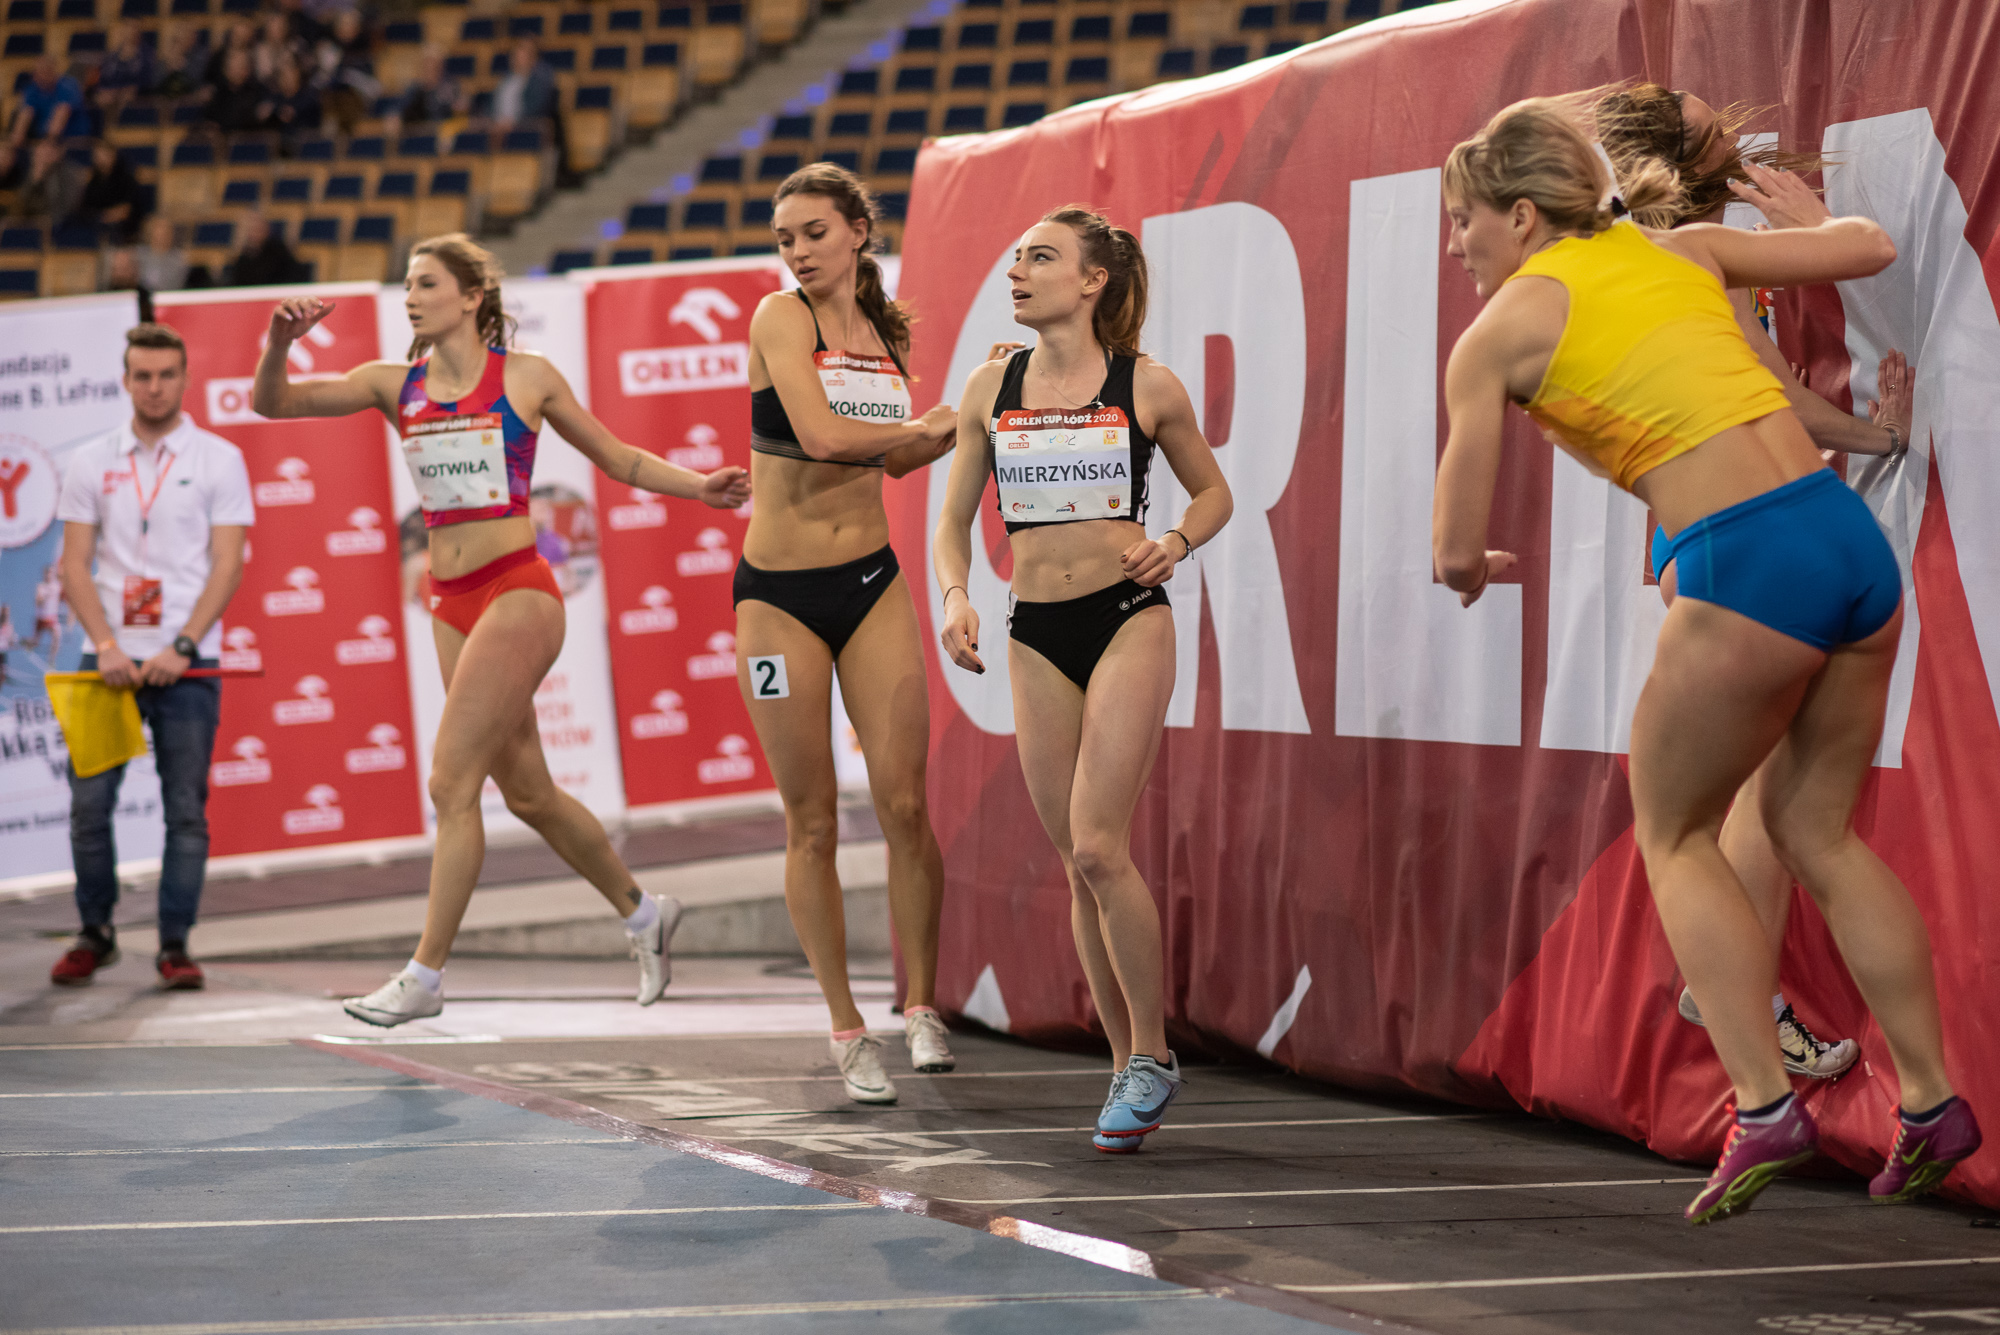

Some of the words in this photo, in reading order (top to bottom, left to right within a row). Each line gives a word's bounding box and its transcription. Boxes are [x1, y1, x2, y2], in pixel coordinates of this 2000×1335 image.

[631, 354, 740, 384] ORLEN
[829, 401, 905, 419] KOŁODZIEJ
[1008, 416, 1041, 426] ORLEN
[1043, 414, 1062, 424] CUP
[1064, 413, 1092, 425] ŁÓDŹ
[1094, 413, 1118, 423] 2020
[419, 459, 490, 478] KOTWIŁA
[999, 459, 1127, 483] MIERZYŃSKA
[1131, 589, 1153, 605] JAKO
[756, 660, 780, 696] 2
